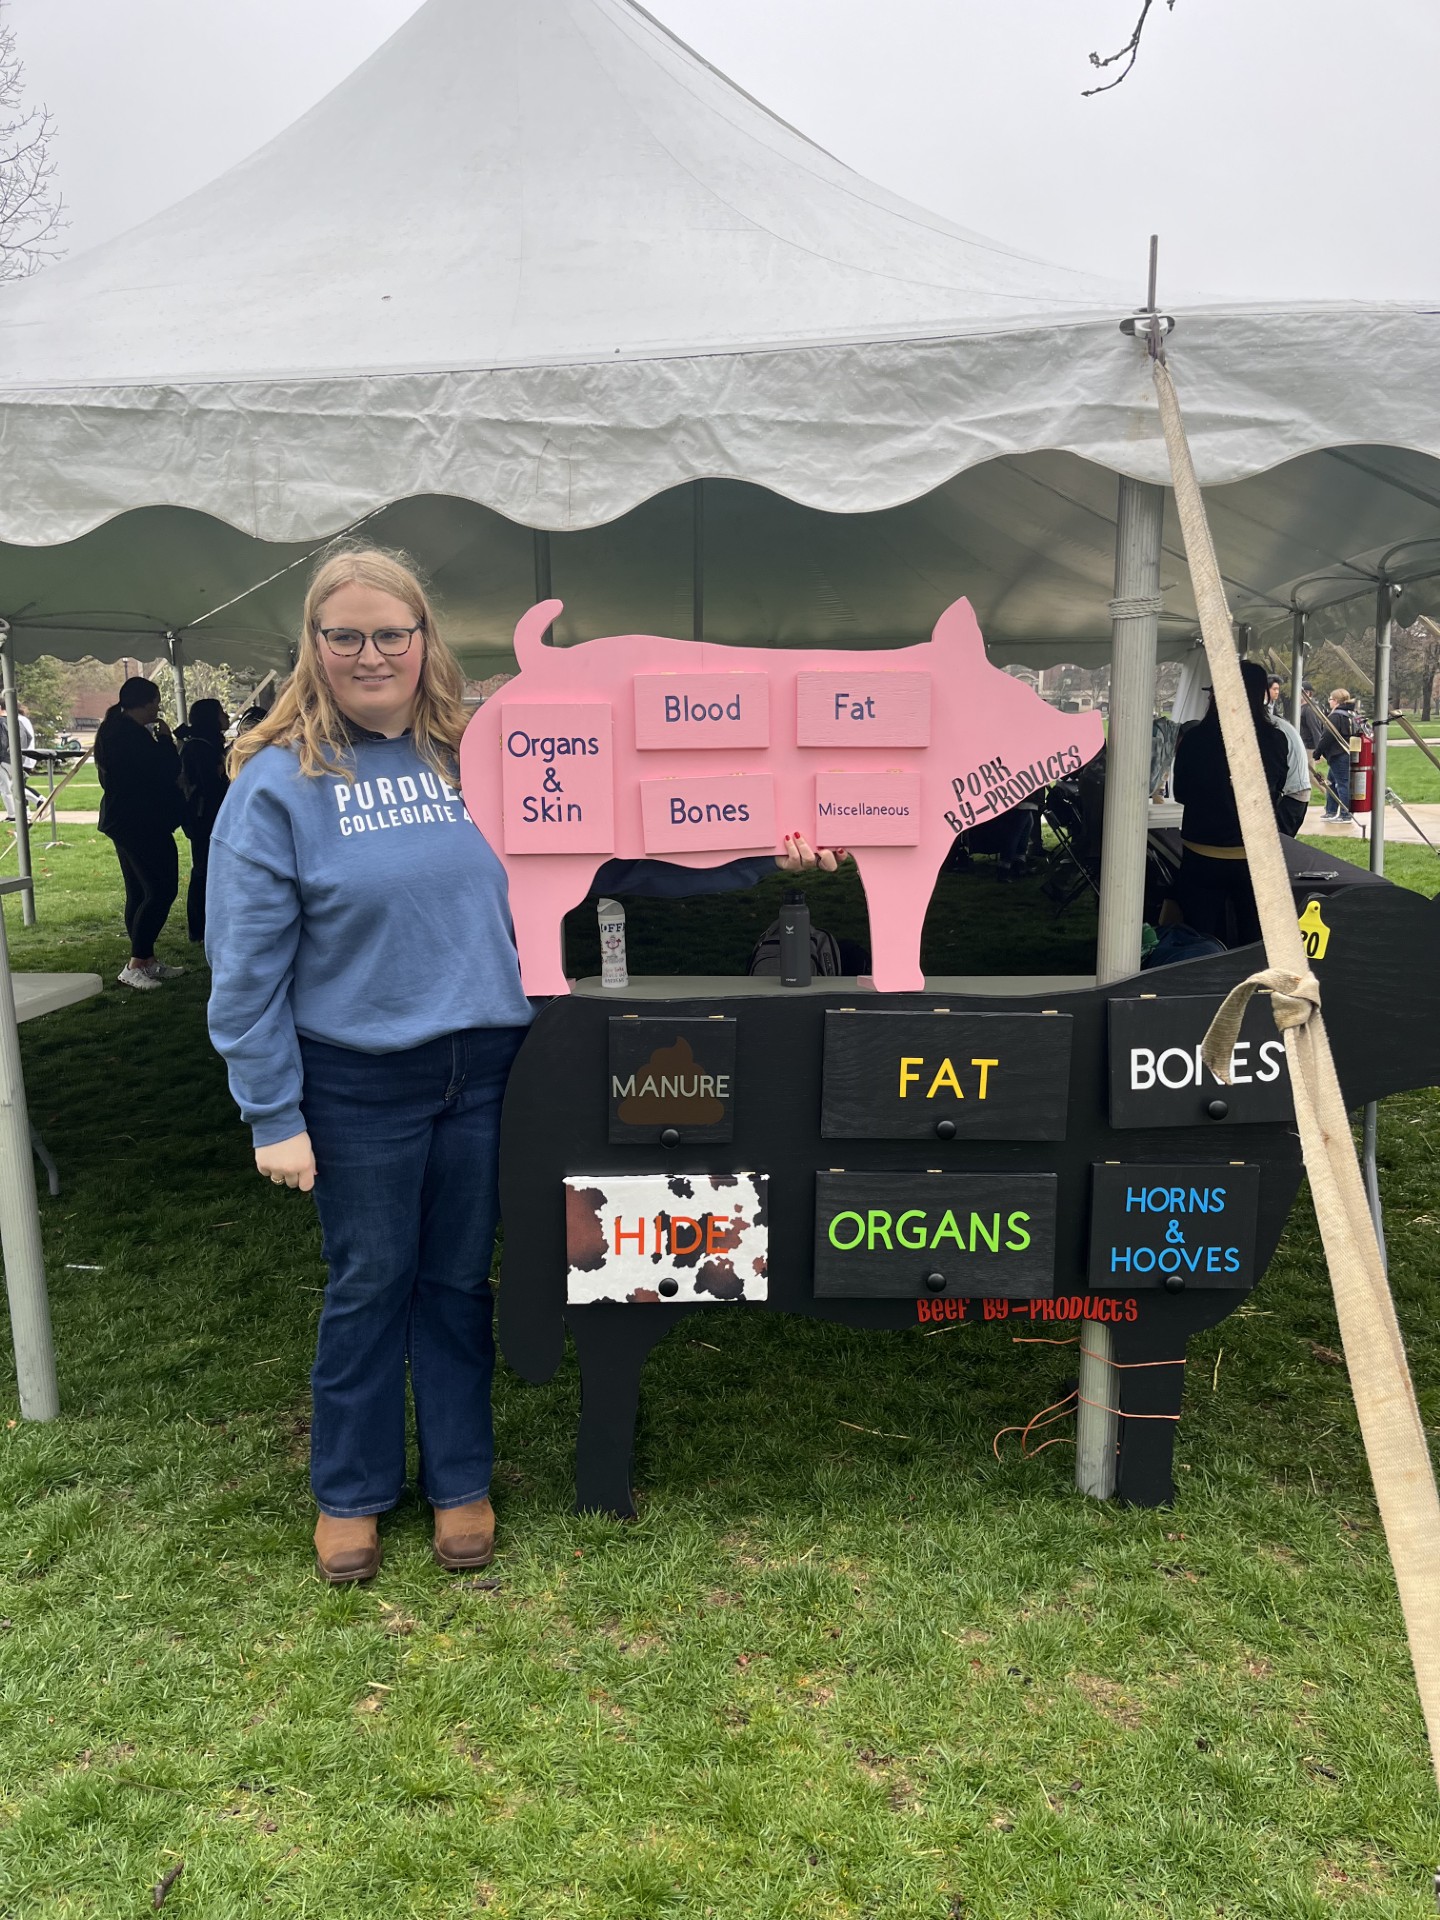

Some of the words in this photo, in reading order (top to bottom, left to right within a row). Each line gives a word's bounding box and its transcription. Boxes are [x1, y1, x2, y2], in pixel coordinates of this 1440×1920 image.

[664, 694, 741, 723] Blood
[835, 693, 876, 721] Fat
[507, 730, 599, 763] Organs
[334, 772, 460, 813] PURDUE
[542, 767, 564, 792] &
[952, 756, 1012, 803] PORK
[340, 804, 457, 837] COLLEGIATE
[522, 796, 582, 823] Skin
[670, 797, 750, 825] Bones
[818, 802, 910, 816] Miscellaneous
[612, 1074, 730, 1098] MANURE
[899, 1056, 999, 1100] FAT
[1125, 1186, 1227, 1214] HORNS
[615, 1215, 729, 1256] HIDE
[828, 1209, 1031, 1253] ORGANS
[1165, 1219, 1186, 1244] &
[1110, 1246, 1240, 1273] HOOVES
